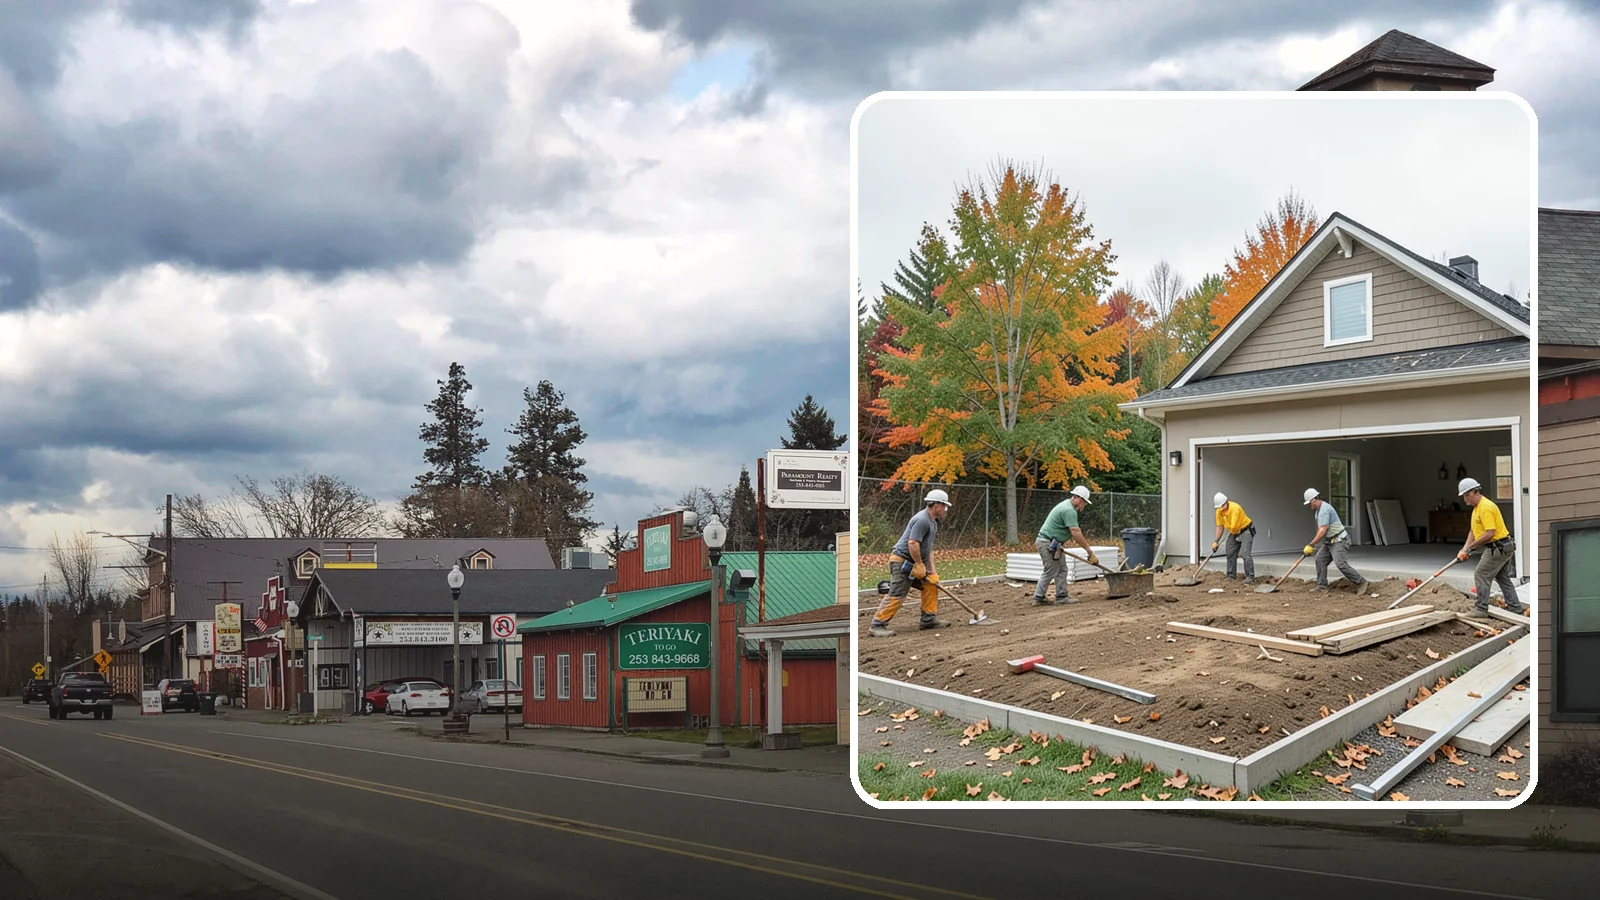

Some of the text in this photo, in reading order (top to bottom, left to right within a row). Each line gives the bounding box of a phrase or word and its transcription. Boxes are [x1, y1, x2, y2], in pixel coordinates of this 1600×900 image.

[781, 471, 814, 479] PARAMOUNT
[625, 627, 702, 646] TERIYAKI
[629, 654, 700, 664] 253 843-9668
